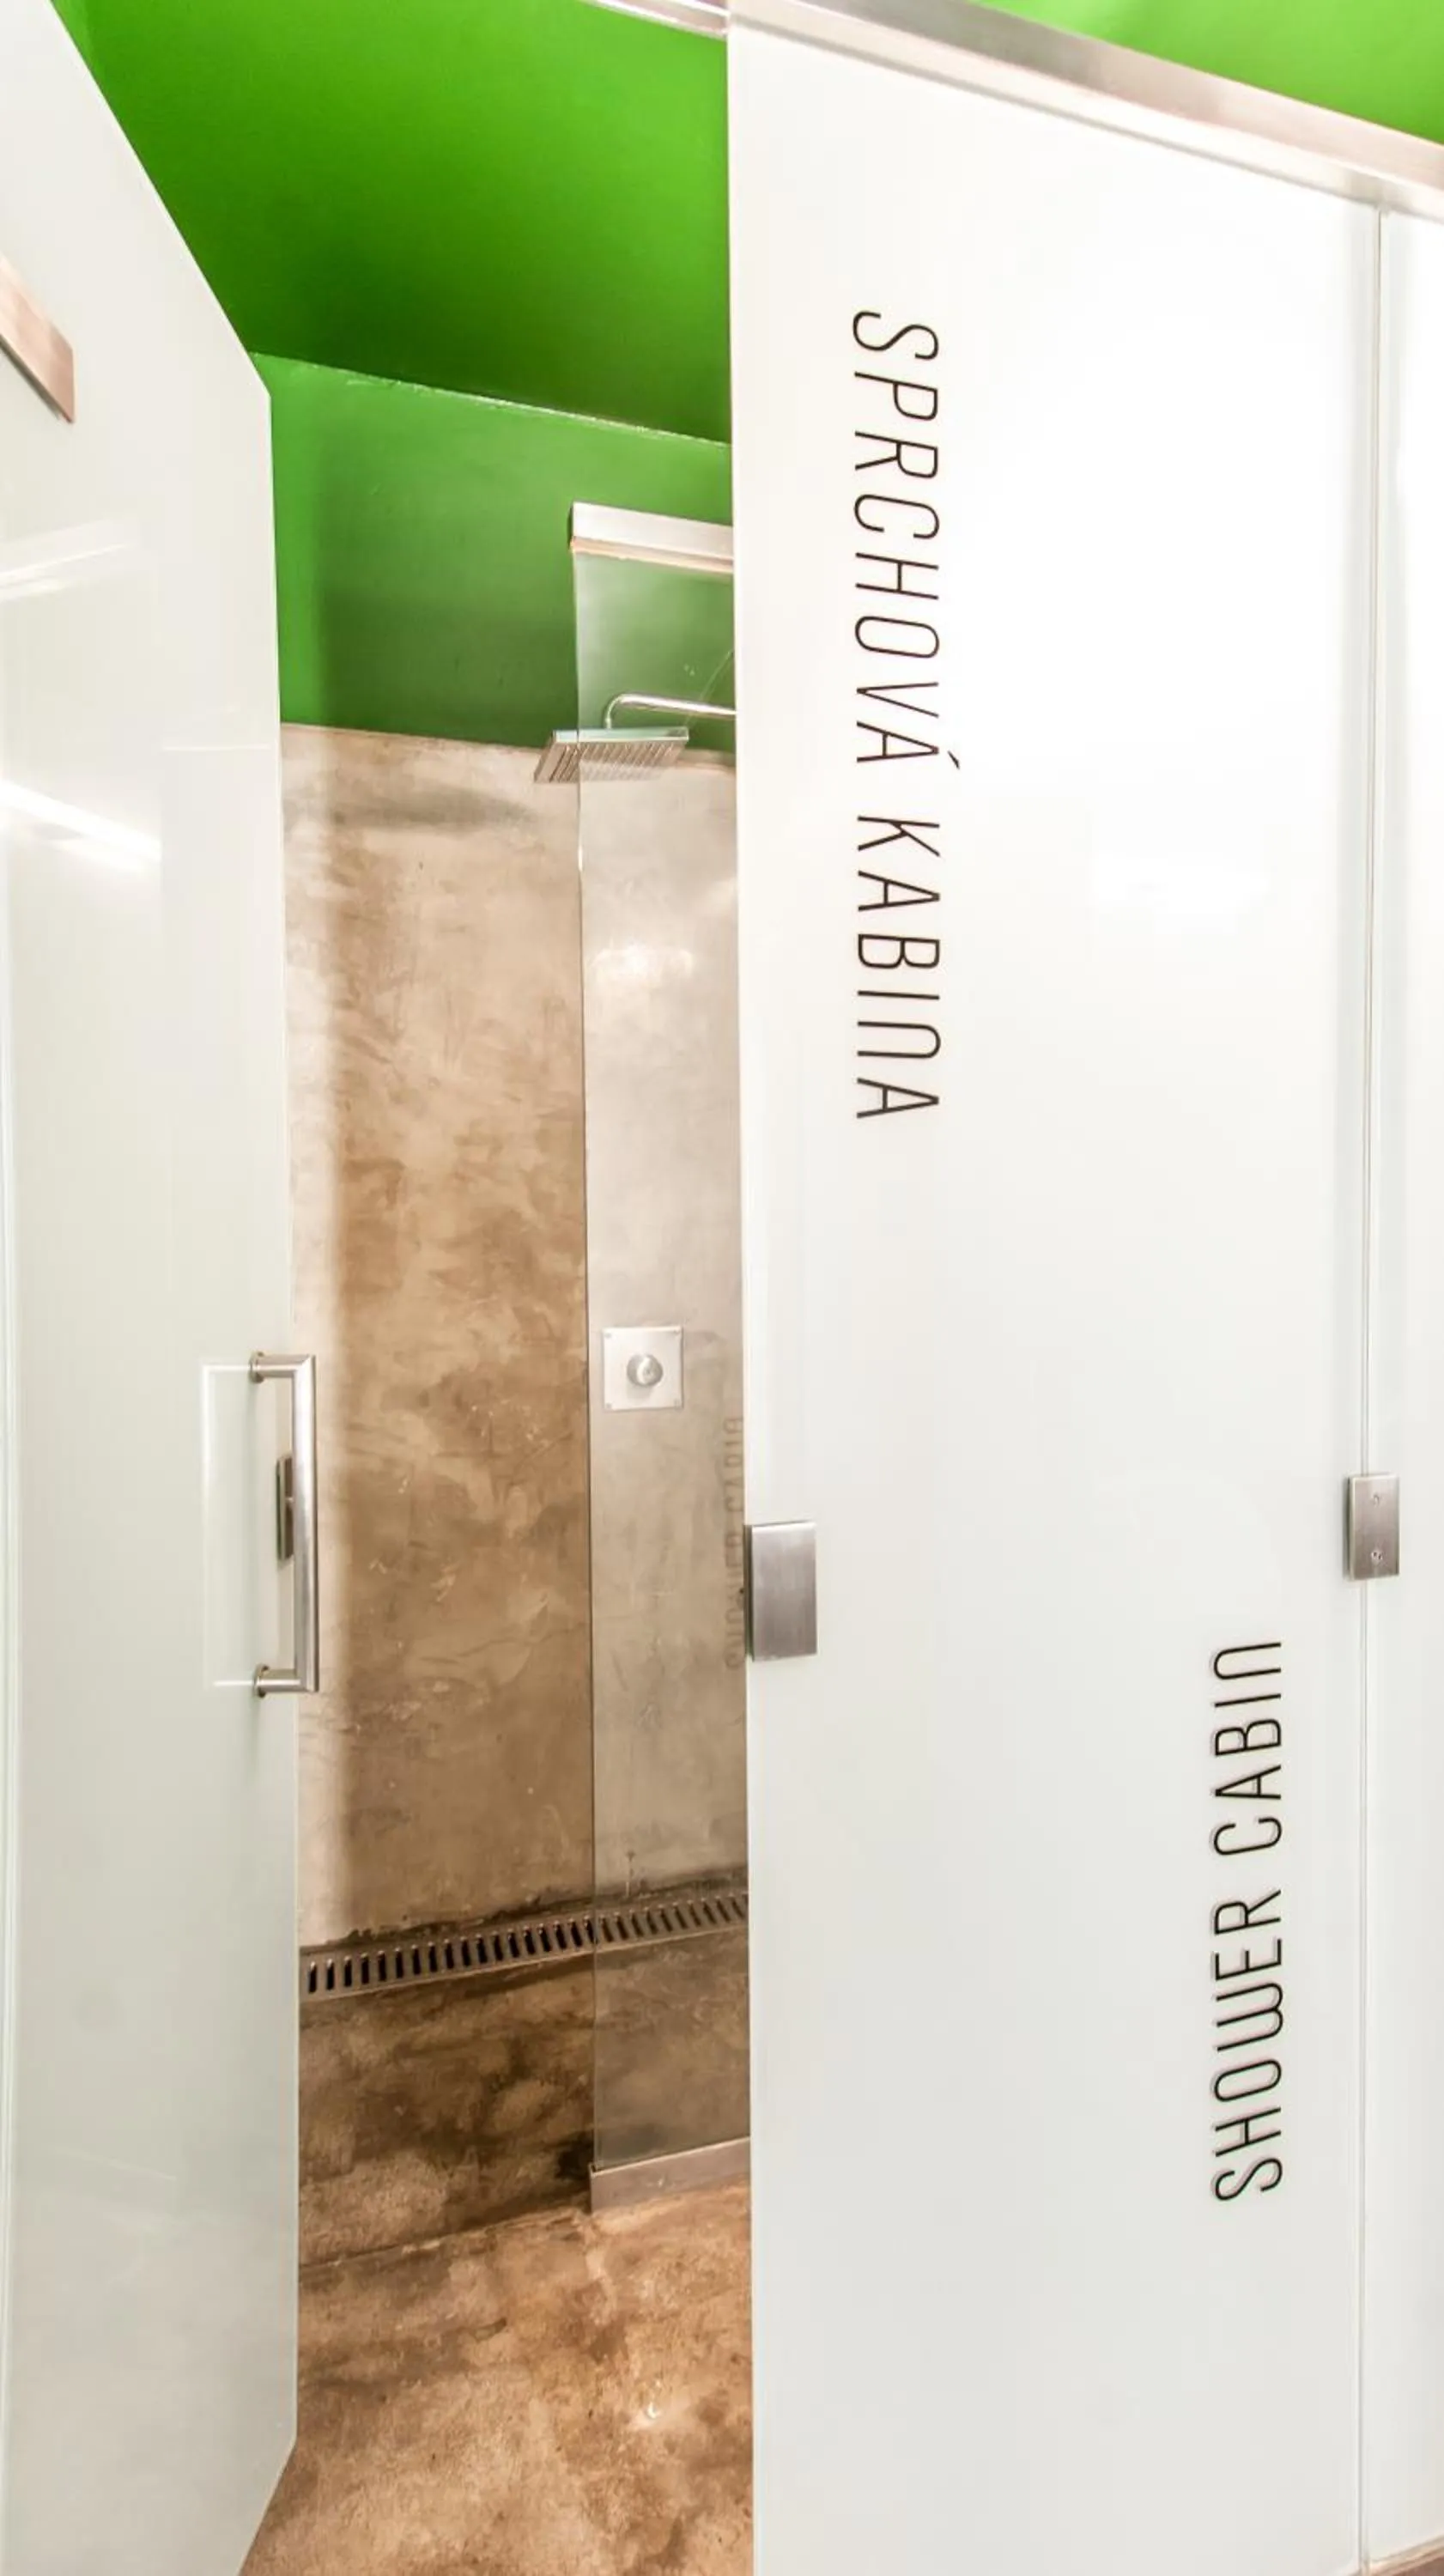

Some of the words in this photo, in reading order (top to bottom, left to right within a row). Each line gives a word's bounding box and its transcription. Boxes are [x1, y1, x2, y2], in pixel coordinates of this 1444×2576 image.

[852, 310, 960, 769] SPRCHOVÁ
[856, 815, 941, 1120] KABINA
[1212, 1640, 1283, 1857] CABIN
[1212, 1888, 1284, 2202] SHOWER
